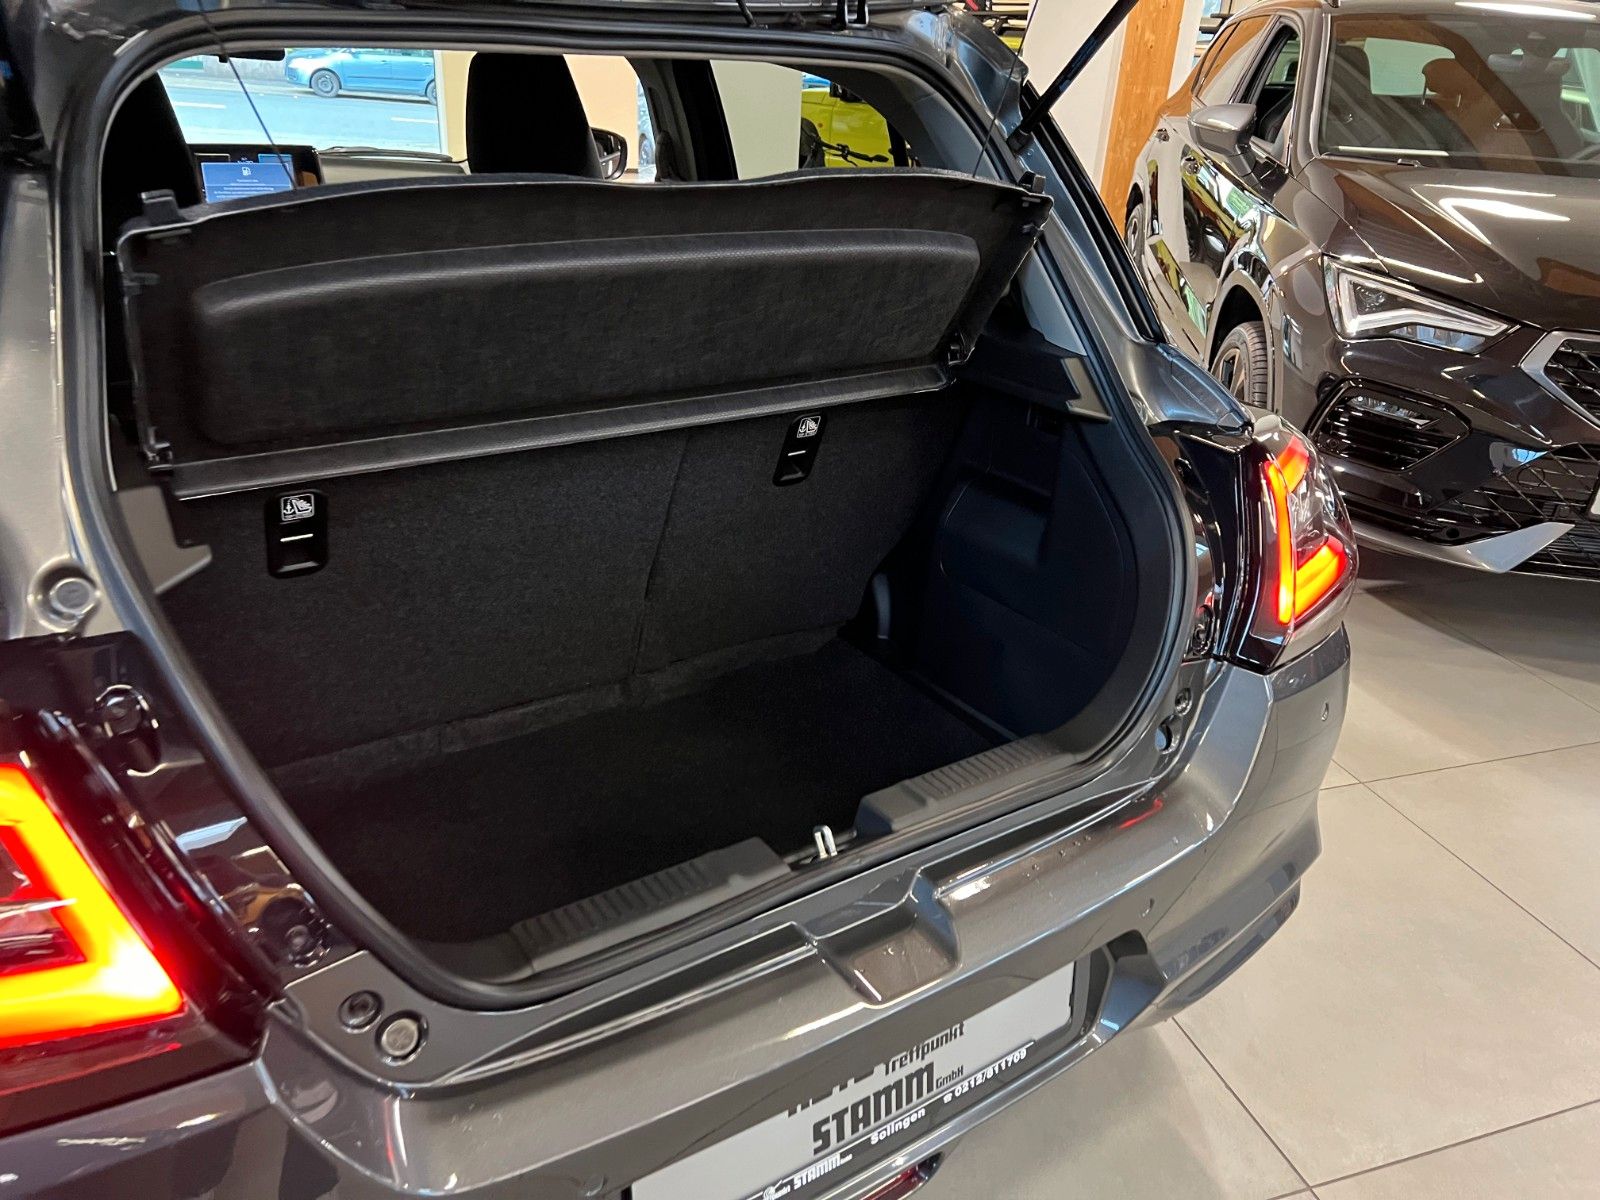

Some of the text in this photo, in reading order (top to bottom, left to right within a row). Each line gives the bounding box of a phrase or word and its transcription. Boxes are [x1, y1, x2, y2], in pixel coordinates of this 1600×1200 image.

[813, 1061, 935, 1155] STAMM
[936, 1065, 964, 1090] GmbH
[870, 1107, 926, 1145] Solingen
